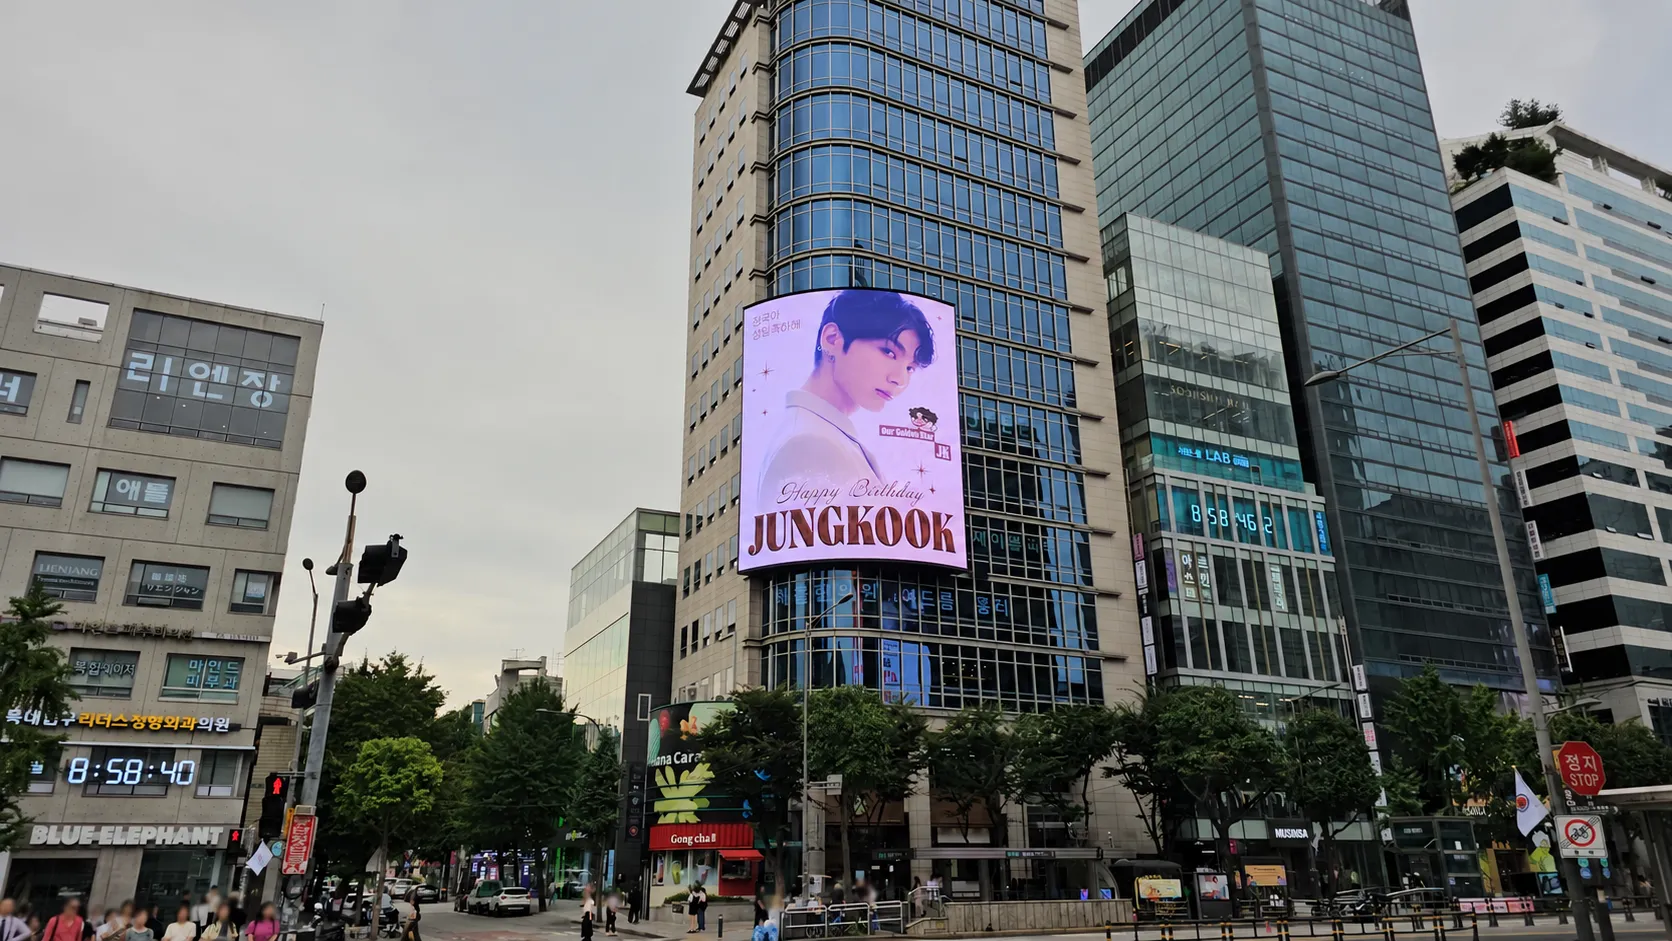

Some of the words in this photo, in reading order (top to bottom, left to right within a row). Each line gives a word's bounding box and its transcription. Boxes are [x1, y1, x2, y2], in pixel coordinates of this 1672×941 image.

[126, 352, 281, 408] 리엔장
[881, 427, 895, 436] Our
[936, 444, 950, 459] JK
[1205, 449, 1231, 464] LAB
[777, 481, 843, 506] Happy
[849, 478, 926, 507] Birthday
[747, 505, 957, 556] JUNGKOOK
[39, 563, 99, 576] LIENJANG
[189, 659, 239, 674] 마인드
[186, 674, 238, 689] 피부과
[1564, 754, 1597, 772] 정지
[67, 757, 196, 786] 8:58:40
[1569, 773, 1599, 787] STOP
[29, 825, 96, 845] BLUE
[98, 826, 224, 846] ELEPHANT
[670, 834, 693, 847] Gong
[694, 832, 711, 844] cha
[1275, 828, 1308, 839] MUSINSA
